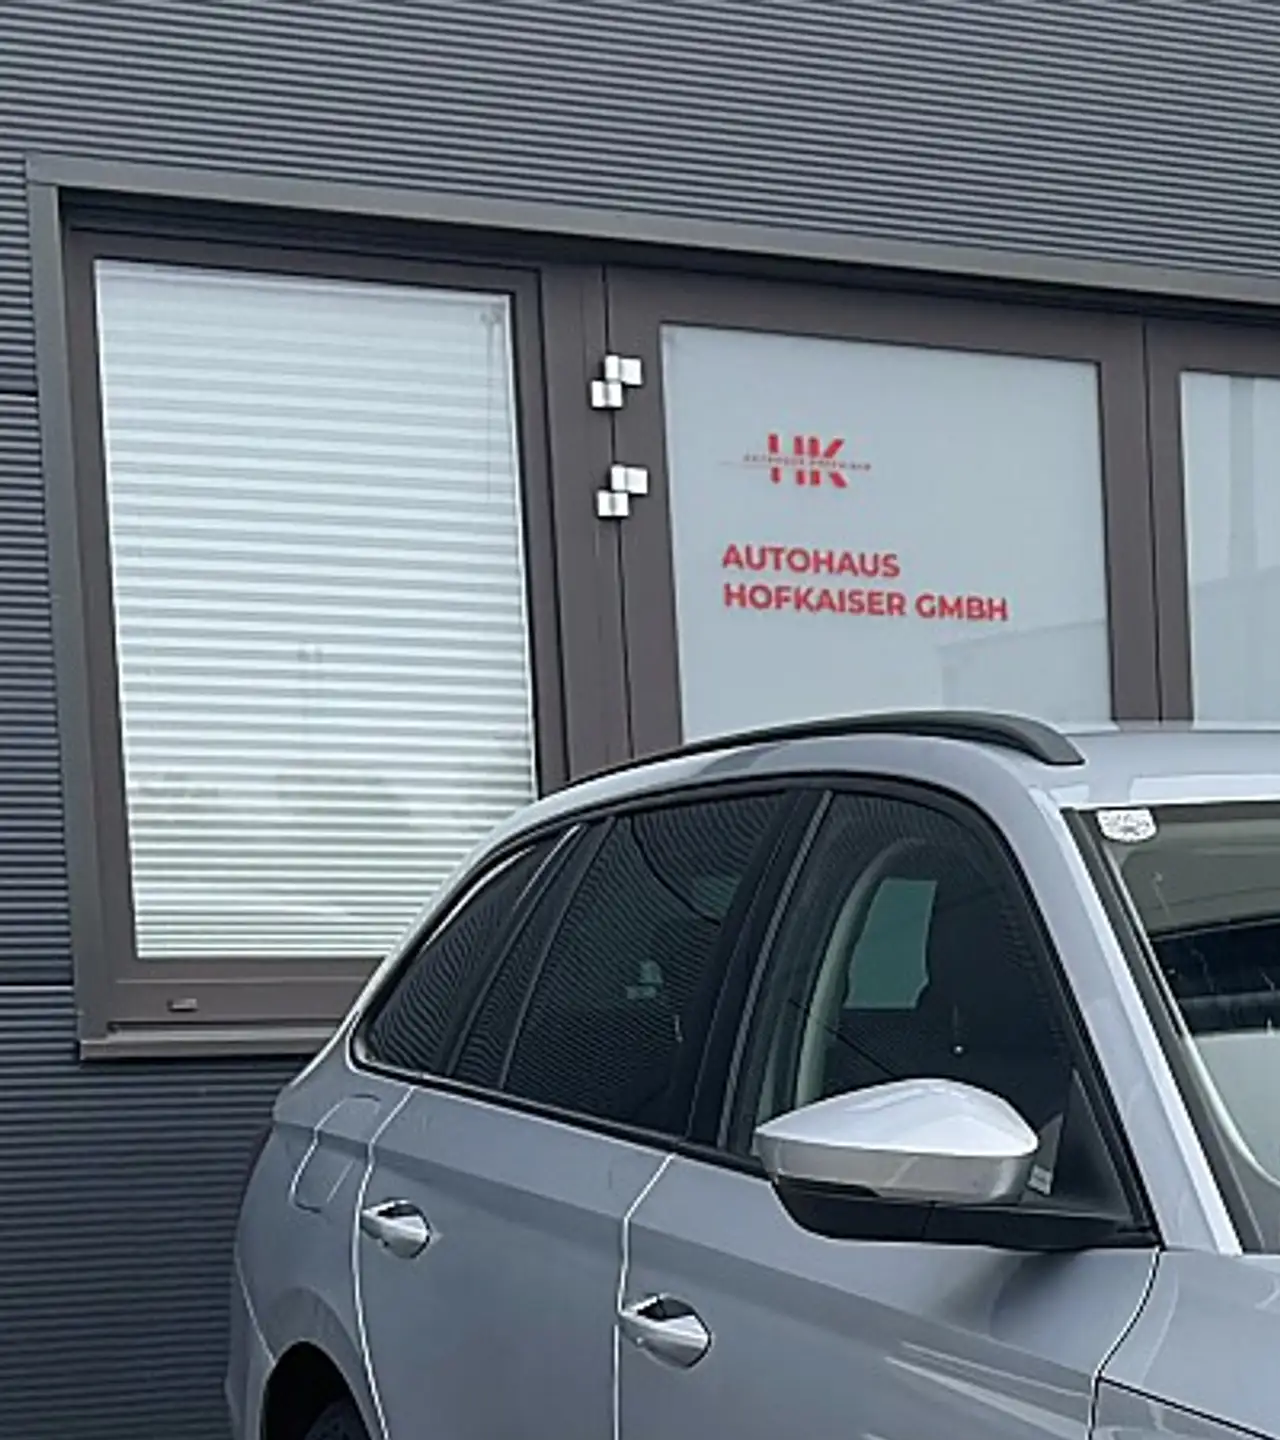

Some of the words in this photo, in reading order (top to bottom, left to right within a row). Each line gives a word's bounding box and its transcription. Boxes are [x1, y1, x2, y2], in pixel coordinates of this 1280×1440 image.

[722, 543, 900, 578] AUTOHAUS
[723, 583, 905, 617] HOFKAISER
[915, 593, 1009, 621] GMBH
